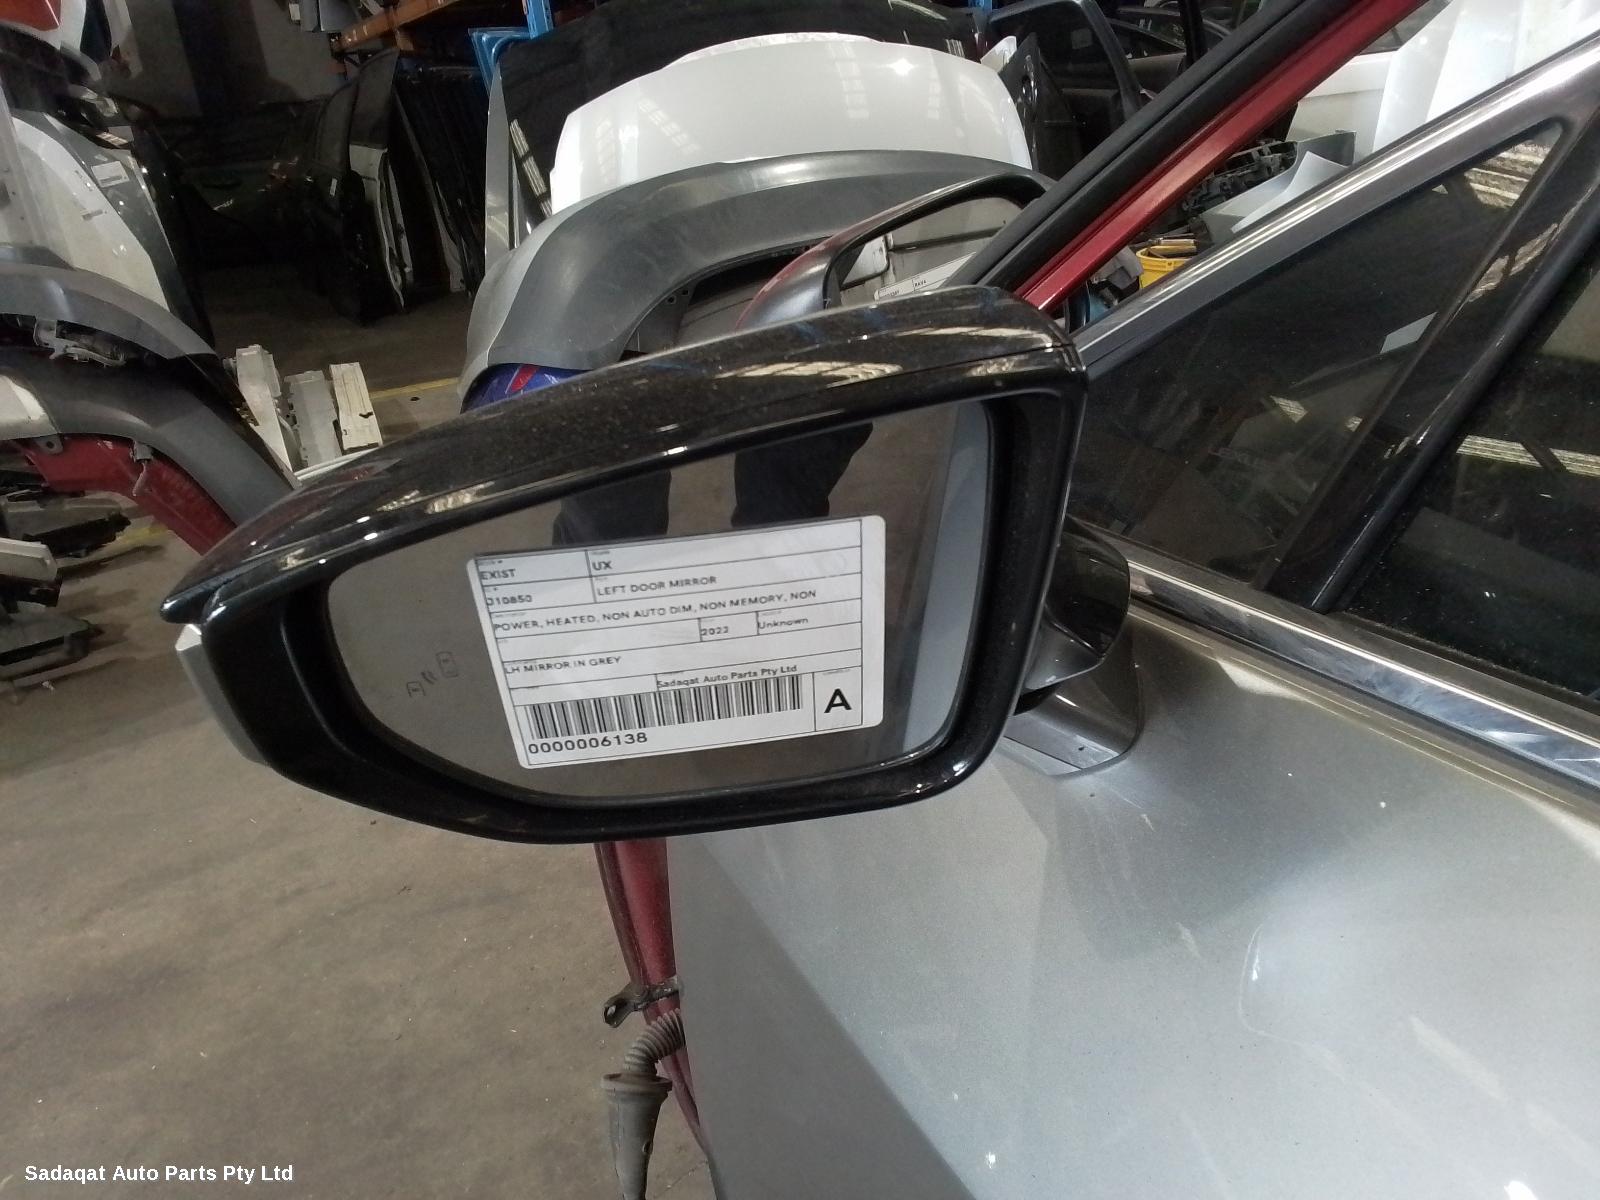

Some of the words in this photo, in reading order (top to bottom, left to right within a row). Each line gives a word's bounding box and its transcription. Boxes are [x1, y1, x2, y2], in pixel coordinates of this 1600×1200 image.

[592, 561, 612, 571] UX
[597, 585, 626, 596] LEFT
[630, 581, 666, 592] DOOR
[669, 576, 717, 588] MIRROR
[494, 620, 544, 631] POWER,
[546, 615, 599, 626] HEATED,
[602, 610, 630, 621] NON
[633, 607, 666, 618] AUTO
[669, 604, 697, 614] DIM,
[699, 601, 726, 610] NON
[729, 593, 788, 607] MEMORY,
[790, 590, 817, 600] NON
[758, 617, 809, 629] Unknown
[505, 666, 520, 674] LH
[523, 661, 571, 673] MIRROR
[574, 660, 586, 668] IN
[589, 656, 621, 666] GREY
[657, 677, 699, 689] Sadaqat
[703, 673, 728, 683] Auto
[731, 670, 758, 680] Parts
[761, 667, 778, 677] Pty
[780, 665, 798, 674] Ltd
[823, 687, 853, 714] A
[528, 732, 648, 754] 0000006138
